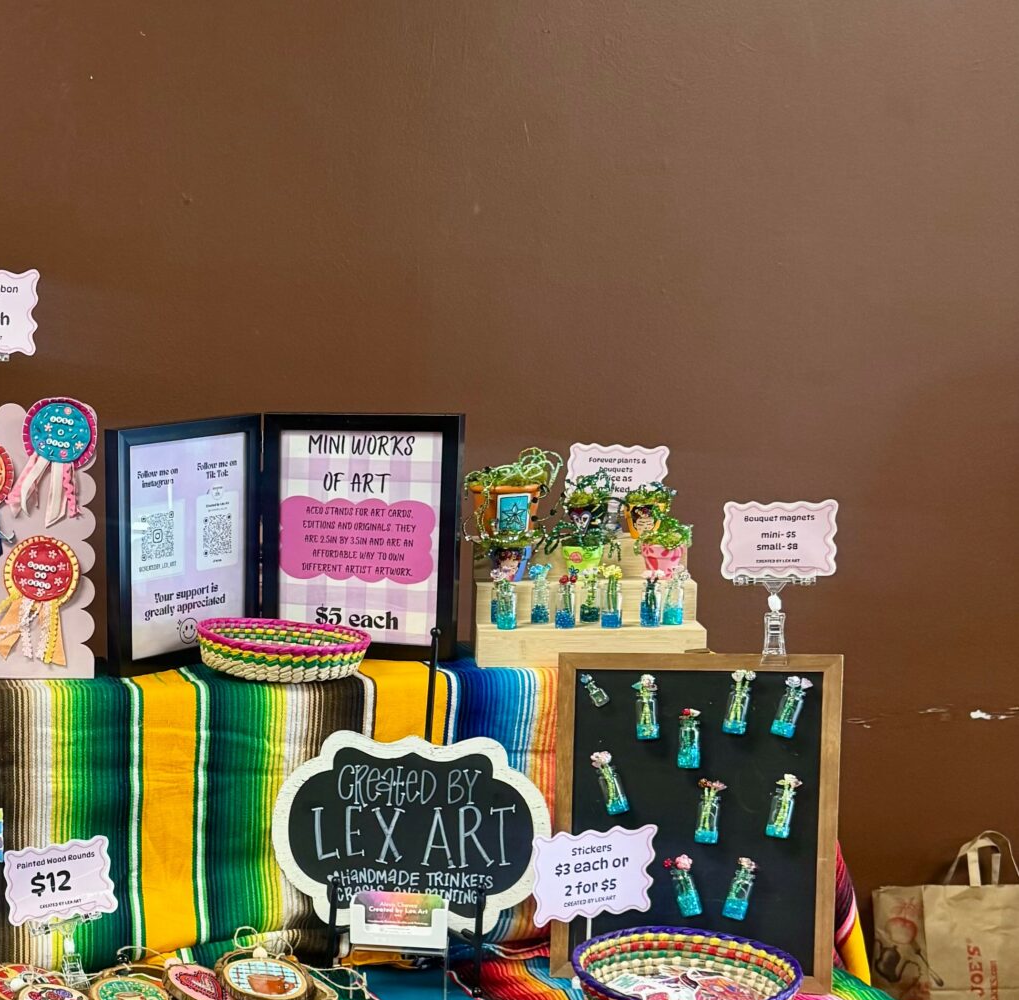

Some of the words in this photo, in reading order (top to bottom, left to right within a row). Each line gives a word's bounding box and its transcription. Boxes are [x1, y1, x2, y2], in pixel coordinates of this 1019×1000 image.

[309, 435, 345, 454] MINI
[351, 435, 415, 456] WORKS
[137, 470, 158, 479] Follow
[197, 462, 217, 471] Follow
[206, 471, 216, 479] Tik
[217, 469, 228, 478] Tok
[323, 472, 345, 491] OF
[350, 473, 391, 493] ART
[306, 506, 323, 514] ACEO
[325, 506, 353, 516] STANDS
[355, 506, 368, 516] FOR
[370, 508, 386, 517] ART
[303, 520, 335, 530] EDITIONS
[338, 521, 352, 530] AND
[396, 523, 416, 533] THEY
[305, 535, 318, 543] ARE
[340, 536, 349, 544] BY
[370, 537, 384, 546] AND
[404, 539, 413, 547] AN
[312, 549, 357, 559] AFFORDABLE
[359, 551, 375, 560] WAY
[378, 552, 387, 560] TO
[388, 553, 404, 561] OWN
[302, 562, 342, 572] DIFFERENT
[345, 565, 372, 574] ARTIST
[154, 592, 174, 603] Your
[176, 585, 209, 599] support
[211, 582, 218, 592] is
[144, 605, 175, 621] greatly
[177, 594, 226, 613] appreciated
[315, 603, 342, 625] $5
[349, 611, 398, 630] each
[448, 769, 481, 805] BY
[311, 806, 405, 864] LEX
[421, 804, 516, 869] ART
[572, 844, 612, 856] Stickers
[17, 859, 45, 870] Painted
[47, 856, 67, 864] Wood
[68, 852, 95, 860] Rounds
[555, 863, 570, 877] $3
[574, 858, 608, 873] each
[612, 857, 629, 868] or
[31, 870, 71, 897] $12
[426, 872, 493, 889] TRINKETS
[565, 885, 572, 896] 2
[576, 881, 598, 895] for
[602, 879, 616, 892] $5
[966, 944, 984, 996] JOE'S
